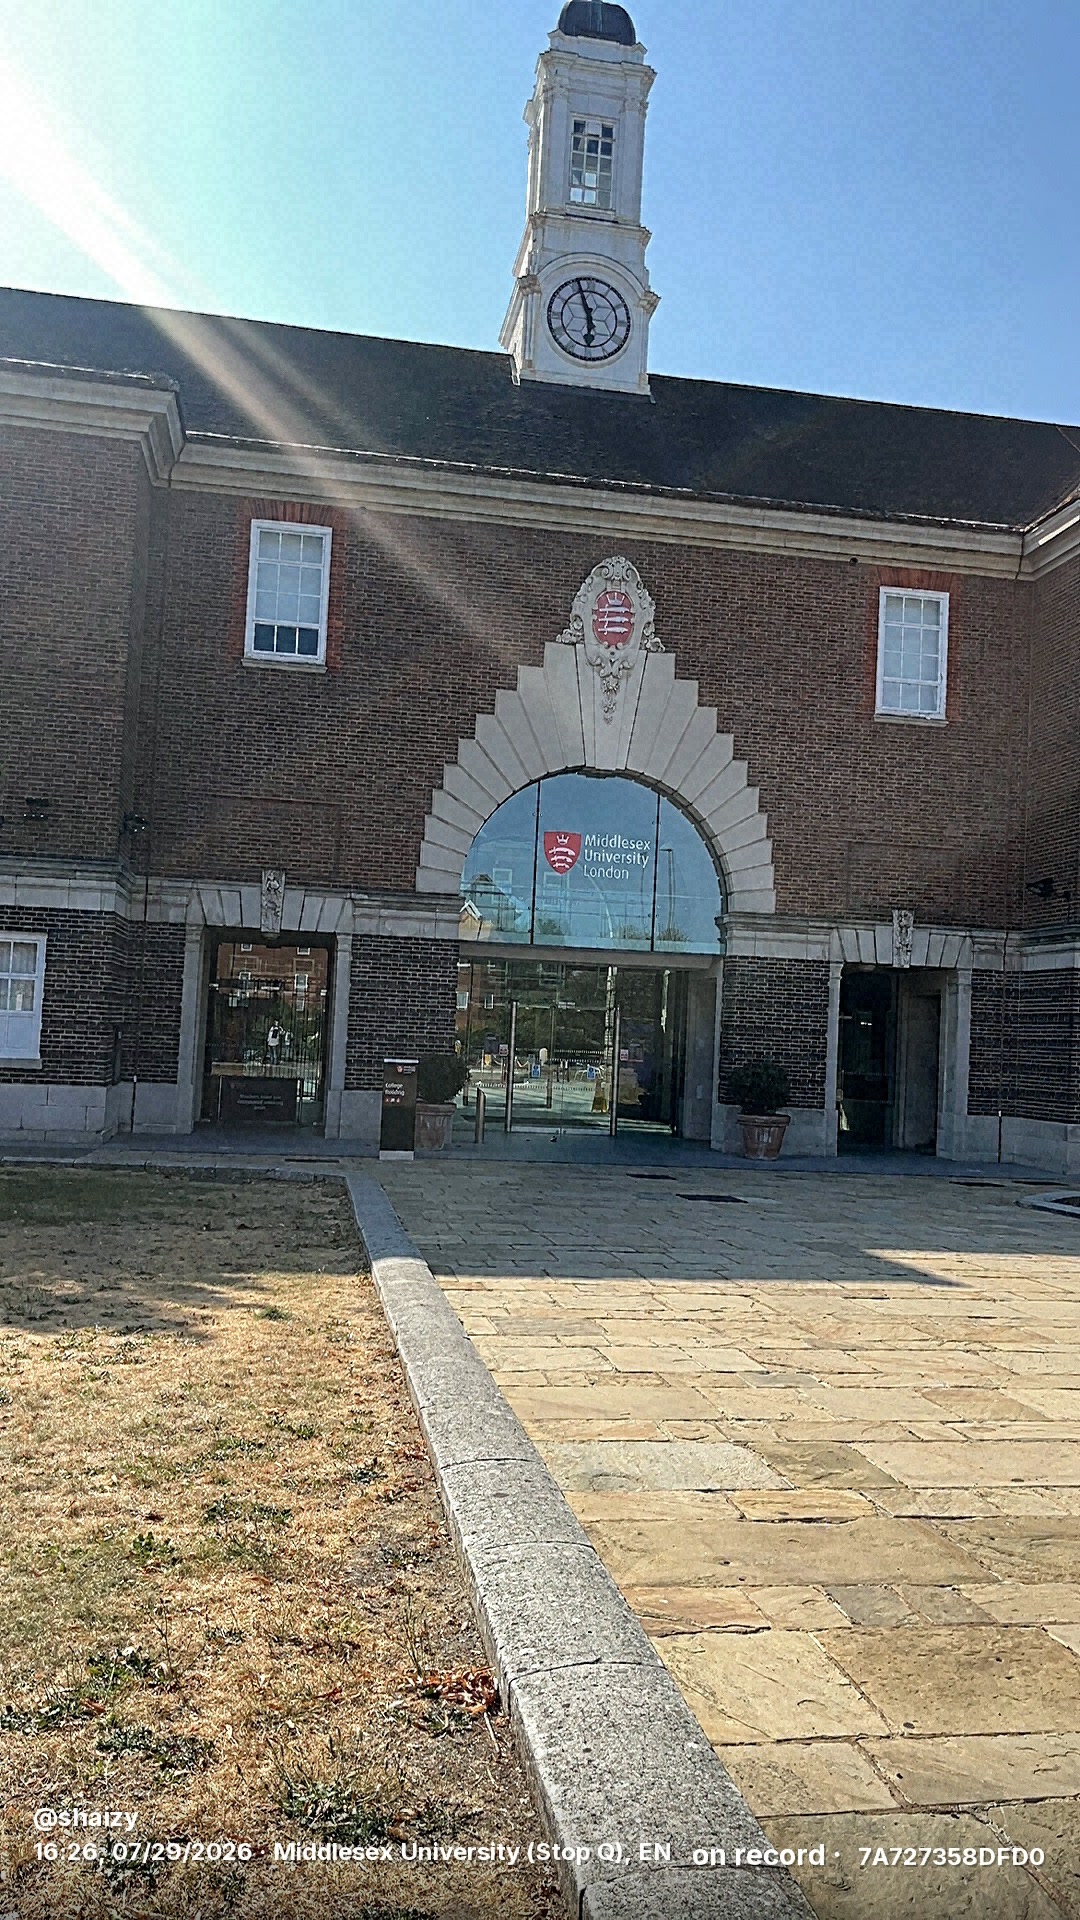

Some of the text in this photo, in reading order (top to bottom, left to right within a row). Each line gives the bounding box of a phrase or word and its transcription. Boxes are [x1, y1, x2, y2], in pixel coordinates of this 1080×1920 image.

[584, 834, 651, 850] Middlesex
[584, 849, 650, 868] University
[583, 865, 629, 880] London
